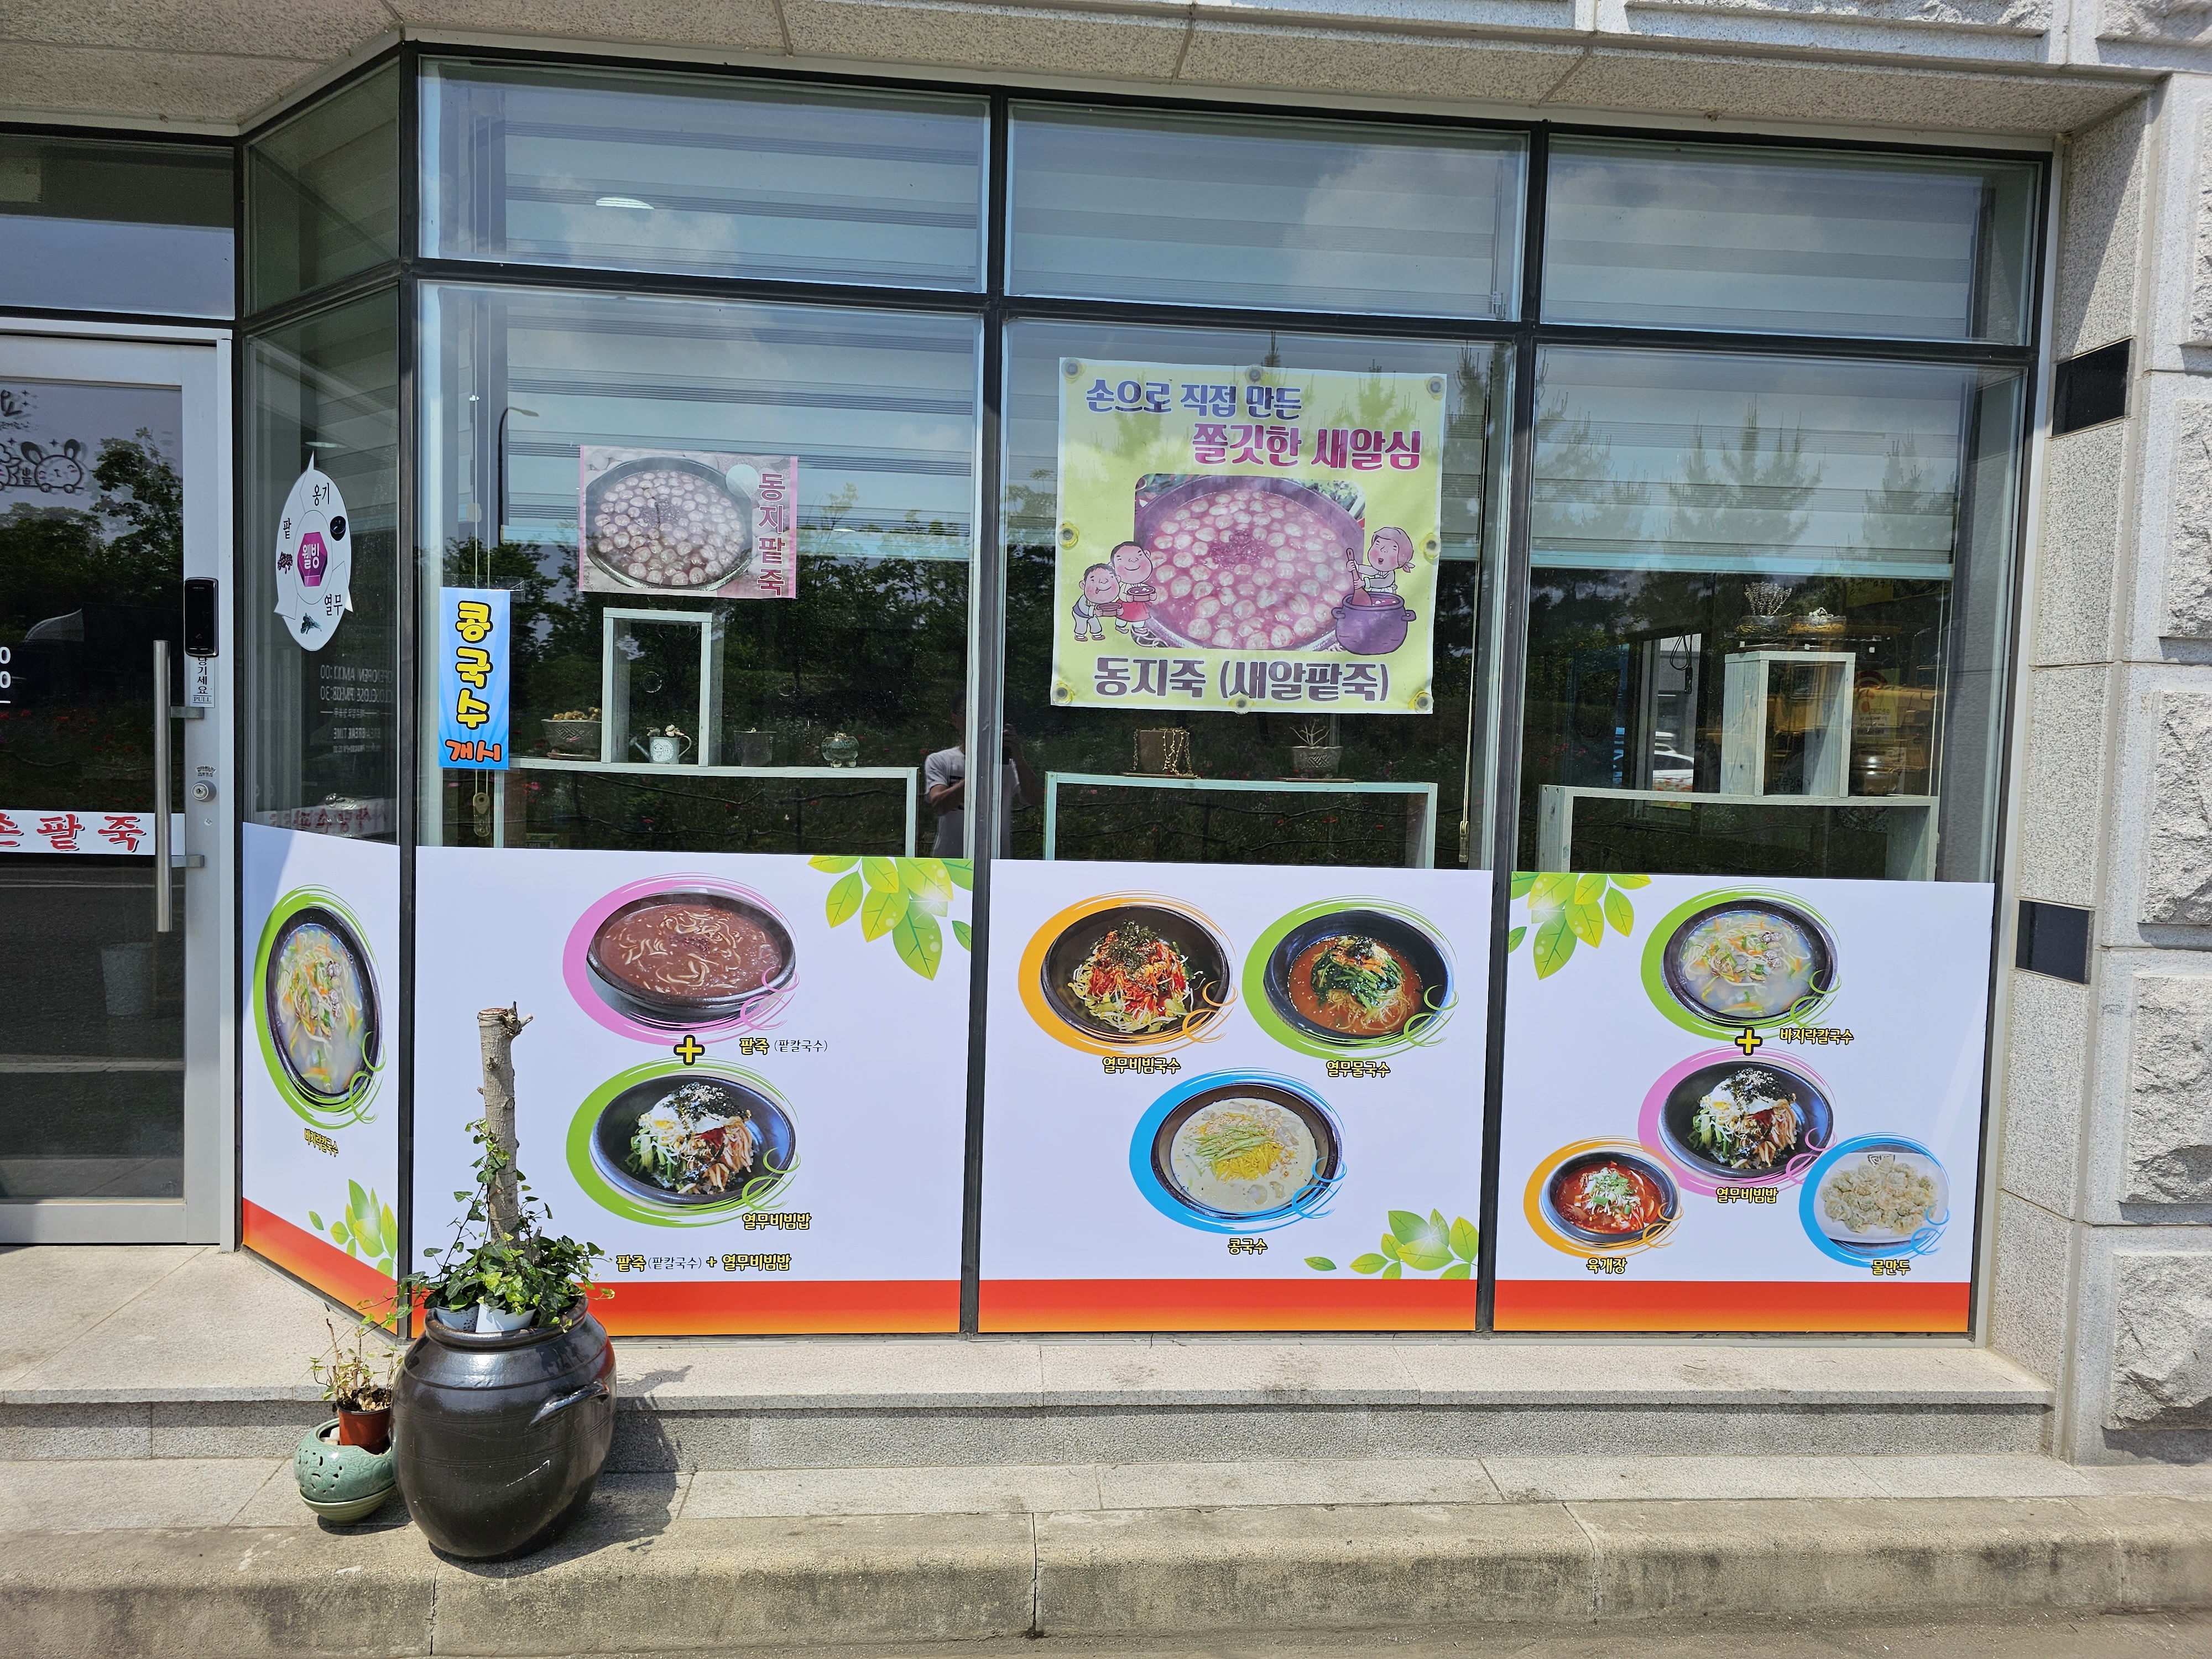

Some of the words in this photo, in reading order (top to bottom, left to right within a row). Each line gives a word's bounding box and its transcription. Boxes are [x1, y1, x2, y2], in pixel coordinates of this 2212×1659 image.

[1086, 379, 1172, 414] 손으로
[1181, 383, 1238, 418] 직접
[1246, 386, 1302, 420] 만든
[1192, 422, 1302, 467] 쫄깃한
[1311, 429, 1421, 470] 새알심
[312, 482, 330, 507] 옹기
[283, 518, 291, 539] 팥
[757, 473, 787, 597] 동지팥죽
[302, 542, 320, 570] 웰빙
[324, 593, 343, 616] 열무
[455, 600, 493, 731] 콩국수
[1094, 657, 1207, 698] 동지죽
[1219, 660, 1389, 703] (새알팥죽)
[445, 739, 502, 763] 개시
[739, 1037, 770, 1056] 팥죽
[774, 1039, 828, 1053] (팥칼국수)
[1780, 1027, 1854, 1045] 바지락칼국수
[1102, 1056, 1181, 1074] 열무비빔국수
[1326, 1060, 1391, 1078] 열무물국수
[304, 1128, 339, 1158] 바지락칼국수
[1716, 1187, 1779, 1204] 열무비빔밥
[742, 1212, 812, 1230] 열무비빔밥
[1228, 1238, 1268, 1255] 콩국수
[721, 1253, 792, 1272] 열무비빔밥
[1586, 1257, 1627, 1274] 육개장
[1871, 1259, 1911, 1276] 물만두
